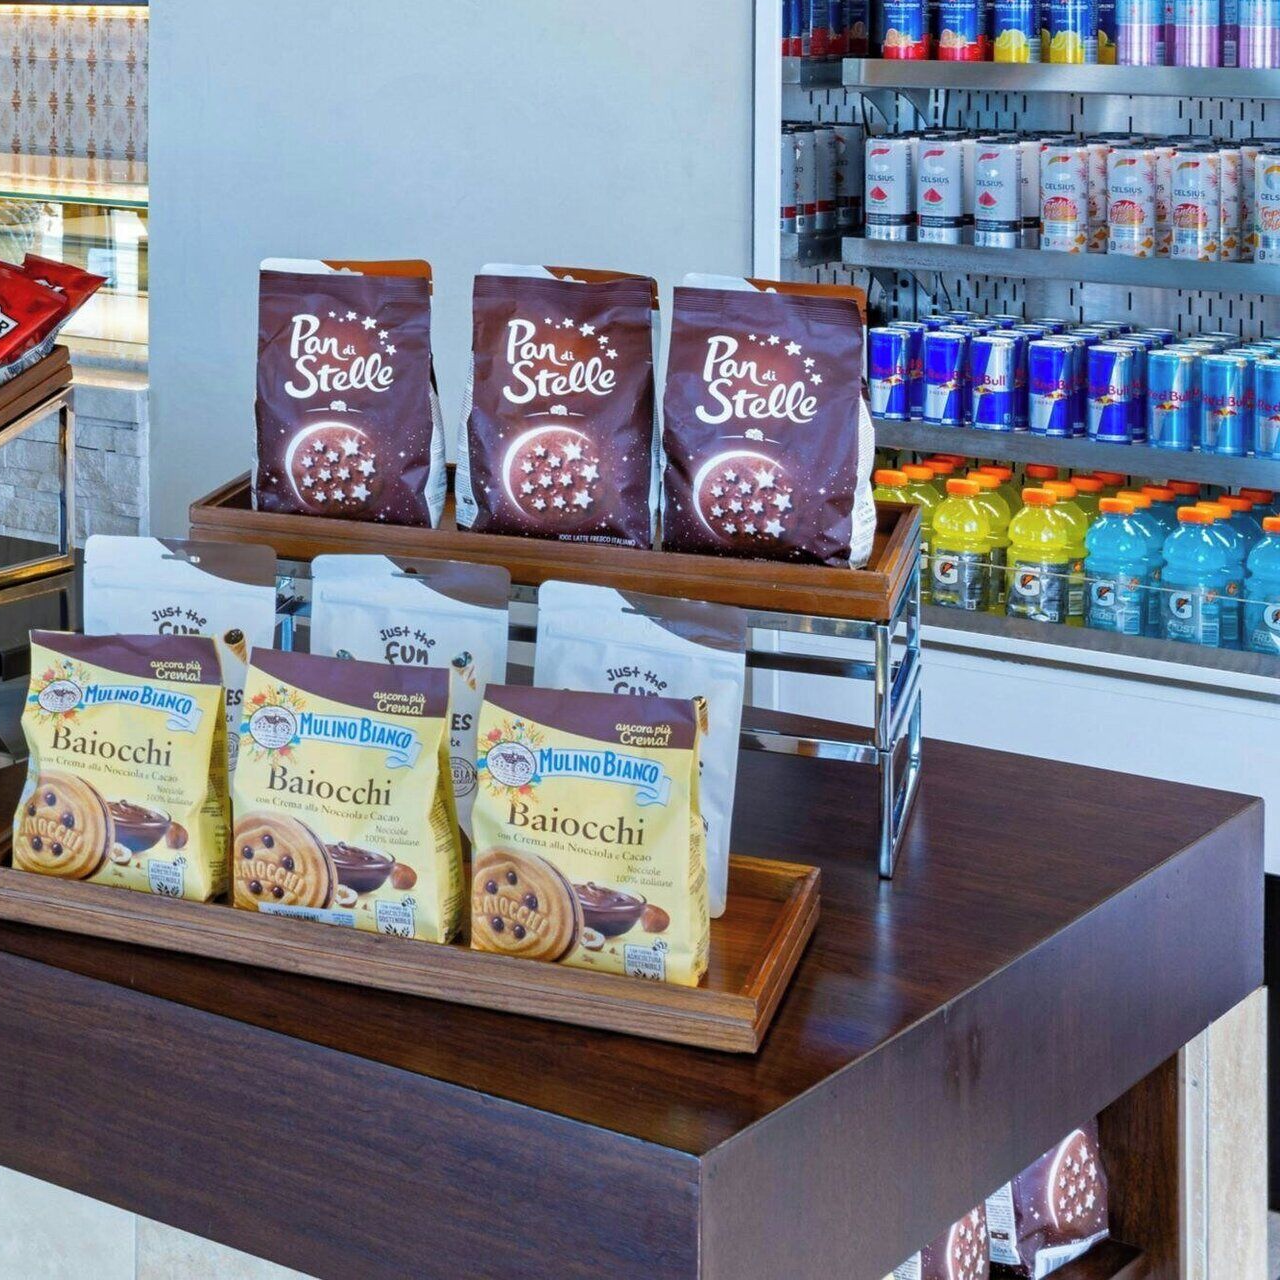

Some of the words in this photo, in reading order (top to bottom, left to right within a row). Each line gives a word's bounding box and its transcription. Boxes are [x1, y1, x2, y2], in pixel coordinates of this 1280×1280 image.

[867, 174, 894, 182] CELSIUS
[976, 179, 1003, 187] CELSIUS
[1111, 186, 1143, 194] CELSIUS
[290, 314, 348, 360] Pan
[342, 344, 356, 356] di
[507, 319, 567, 366] Pan
[560, 349, 575, 362] di
[702, 335, 770, 385] Pan
[762, 370, 777, 383] di
[284, 352, 394, 399] Stelle
[503, 357, 616, 404] Stelle
[985, 375, 1006, 386] Bull
[695, 379, 817, 424] Stelle
[611, 537, 636, 546] ITALIANO
[152, 606, 182, 622] Just
[185, 609, 207, 627] the
[380, 625, 410, 641] Just
[414, 629, 436, 648] the
[150, 661, 184, 670] ancora
[184, 661, 202, 670] più
[155, 669, 201, 682] Crema!
[607, 666, 640, 682] Just
[645, 669, 667, 690] the
[84, 684, 138, 703] MULINO
[140, 686, 194, 715] BIANCO
[373, 691, 408, 702] ancora
[409, 694, 426, 705] più
[377, 700, 424, 716] Crema!
[300, 712, 356, 738] MULINO
[359, 720, 412, 749] BIANCO
[616, 723, 653, 734] ancora
[654, 724, 672, 736] più
[620, 732, 669, 746] Crema!
[51, 726, 173, 767] Baiocchi
[55, 755, 86, 770] Crema
[103, 763, 143, 779] Nocciola
[151, 772, 178, 783] Cacao
[540, 748, 601, 775] MULINO
[605, 751, 659, 783] BIANCO
[268, 764, 392, 806] Baiocchi
[272, 797, 302, 811] Crema
[321, 804, 363, 821] Nocciola
[370, 811, 400, 823] Cacao
[507, 802, 644, 846] Baiocchi
[512, 833, 546, 848] Crema
[549, 839, 565, 851] alla
[567, 842, 613, 860] Nocciola
[622, 851, 652, 862] Cacao
[627, 865, 661, 876] Nocciole
